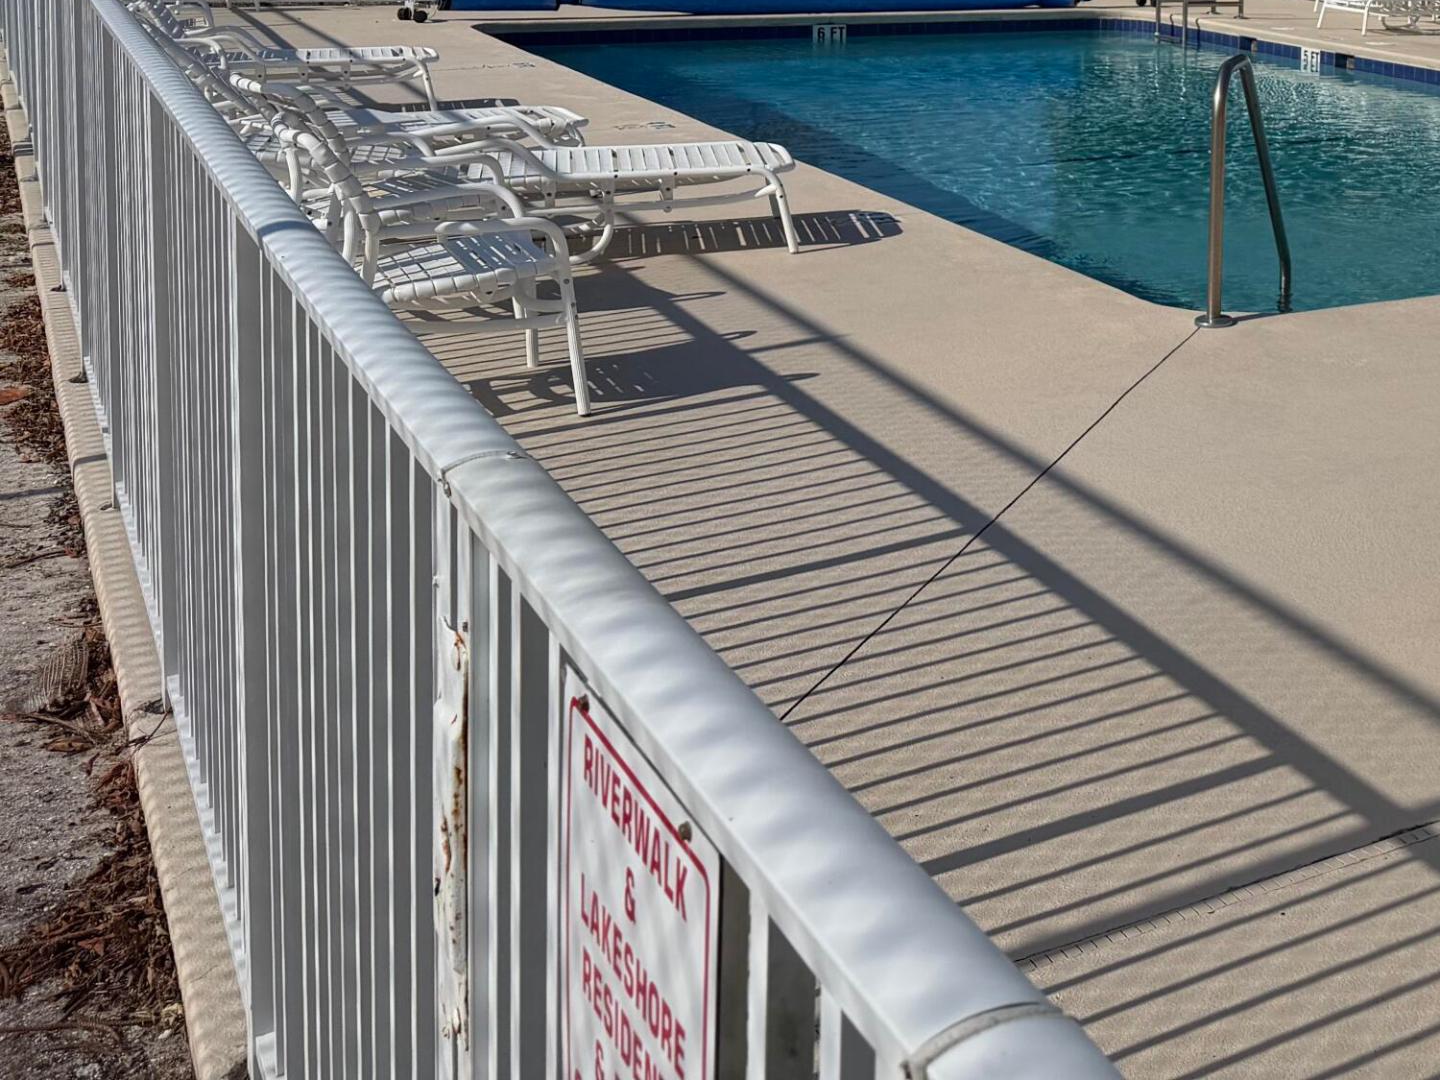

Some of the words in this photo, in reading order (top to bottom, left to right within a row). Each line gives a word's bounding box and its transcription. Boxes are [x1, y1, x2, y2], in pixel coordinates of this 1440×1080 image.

[817, 26, 826, 40] 6
[830, 26, 846, 41] FT
[584, 734, 687, 923] RIVERWALK
[625, 866, 636, 924] &
[581, 872, 685, 1080] LAKESHORE
